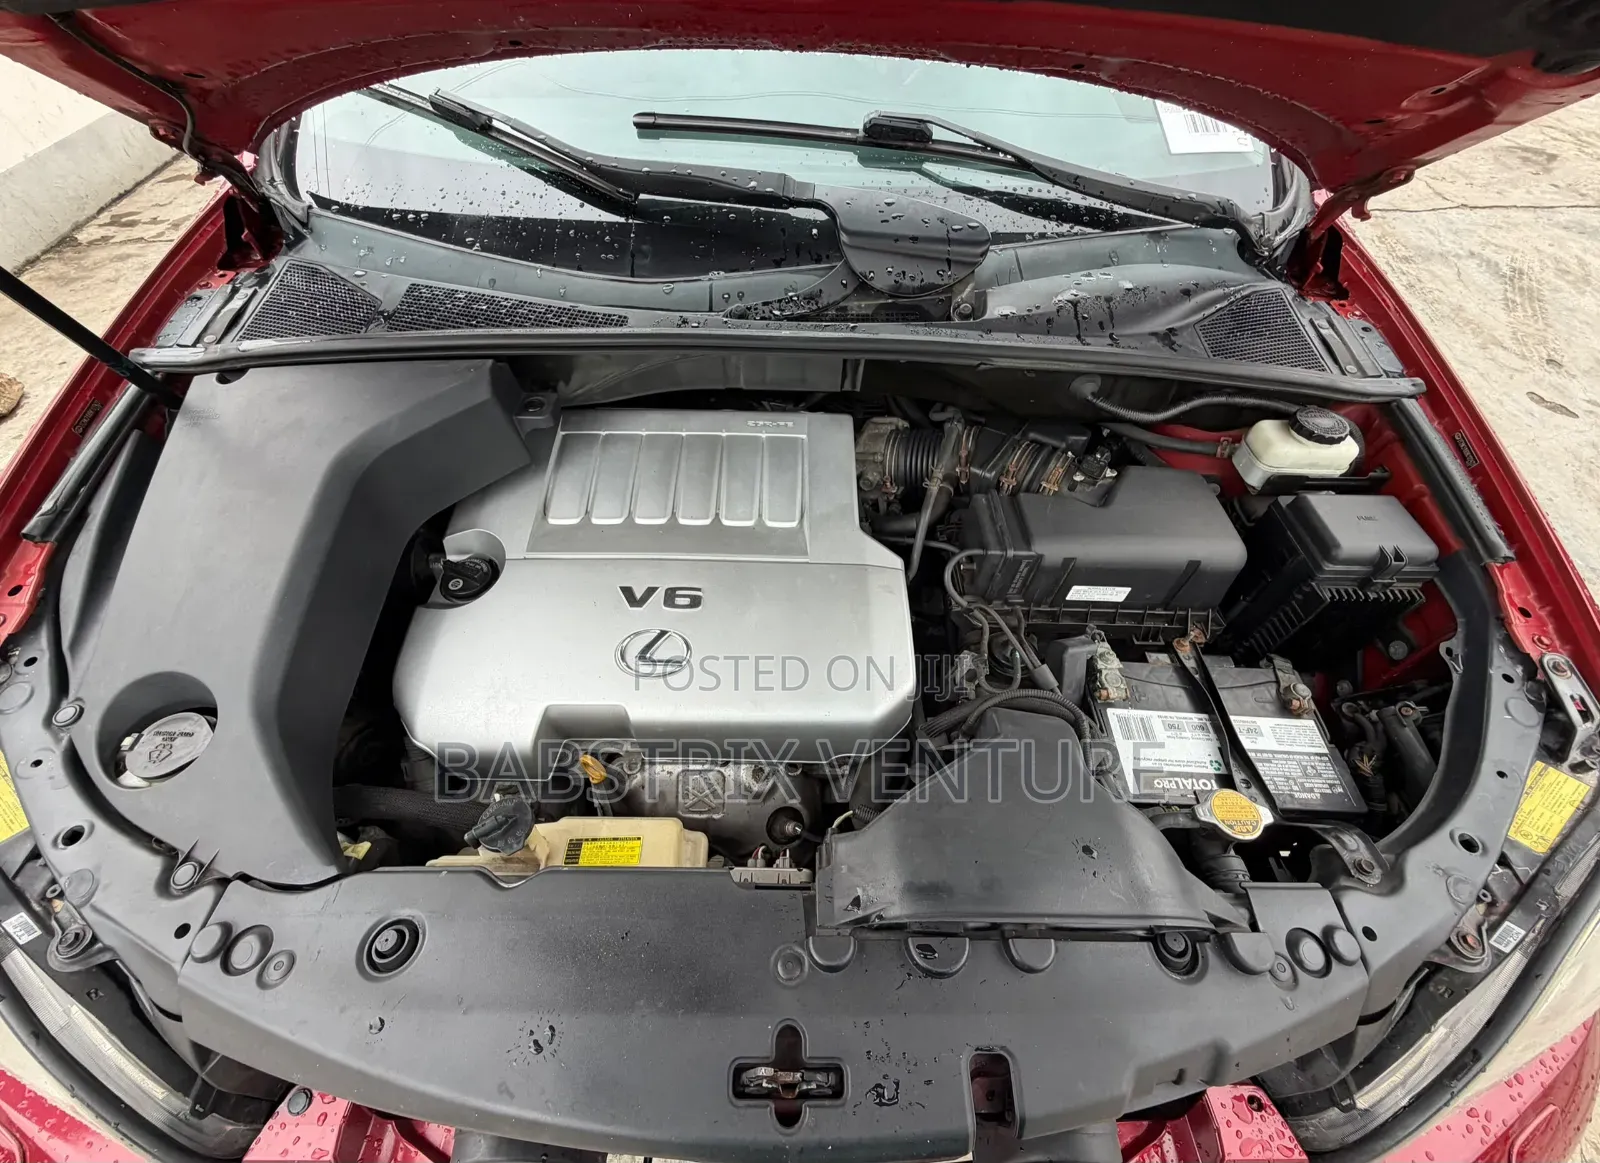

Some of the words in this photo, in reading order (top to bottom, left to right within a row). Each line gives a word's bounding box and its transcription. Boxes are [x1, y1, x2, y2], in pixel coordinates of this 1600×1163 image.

[618, 586, 703, 610] V6
[1167, 722, 1182, 730] 750
[1154, 776, 1219, 791] TOTALPRO
[1224, 819, 1257, 827] CAUTION
